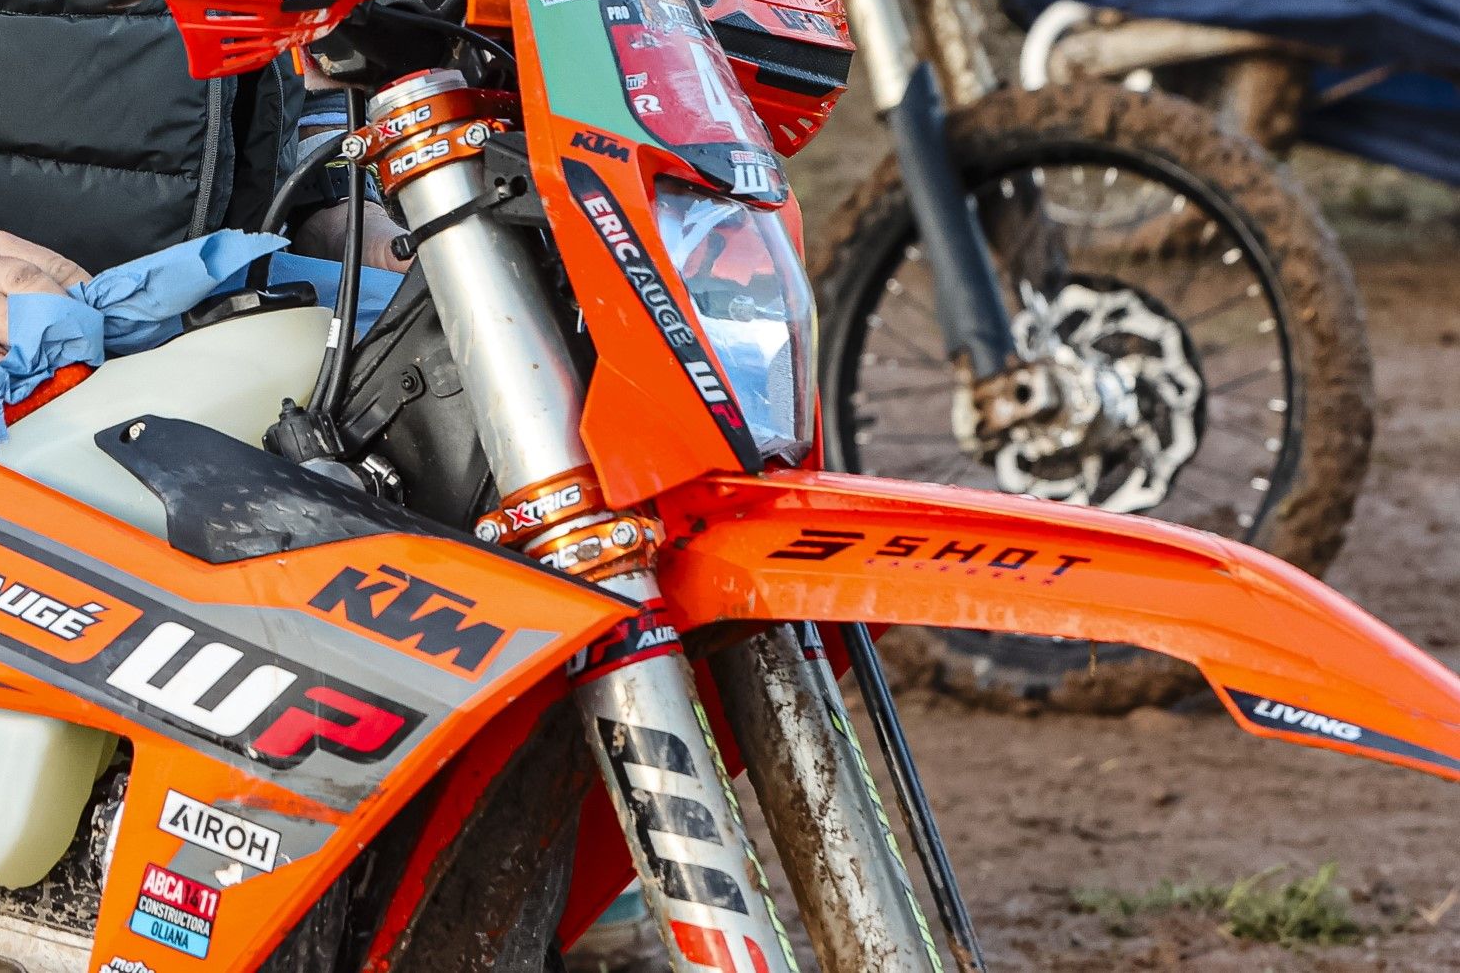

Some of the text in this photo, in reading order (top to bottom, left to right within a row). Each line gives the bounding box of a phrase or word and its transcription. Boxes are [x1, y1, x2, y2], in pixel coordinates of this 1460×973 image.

[607, 6, 630, 20] PRO
[689, 42, 747, 142] 4
[375, 105, 431, 142] XTRIG
[390, 139, 449, 175] ROCS
[571, 130, 630, 163] KTM
[583, 193, 640, 262] ERIC
[504, 484, 581, 530] XTRIG
[875, 535, 1091, 576] SHOT
[308, 564, 505, 672] KTM
[636, 625, 681, 651] AUG
[106, 621, 404, 758] WP
[1253, 699, 1362, 741] LIVING
[169, 804, 269, 861] AIROH
[138, 895, 210, 937] CONSTRUCTORA
[151, 920, 190, 950] OLIANA
